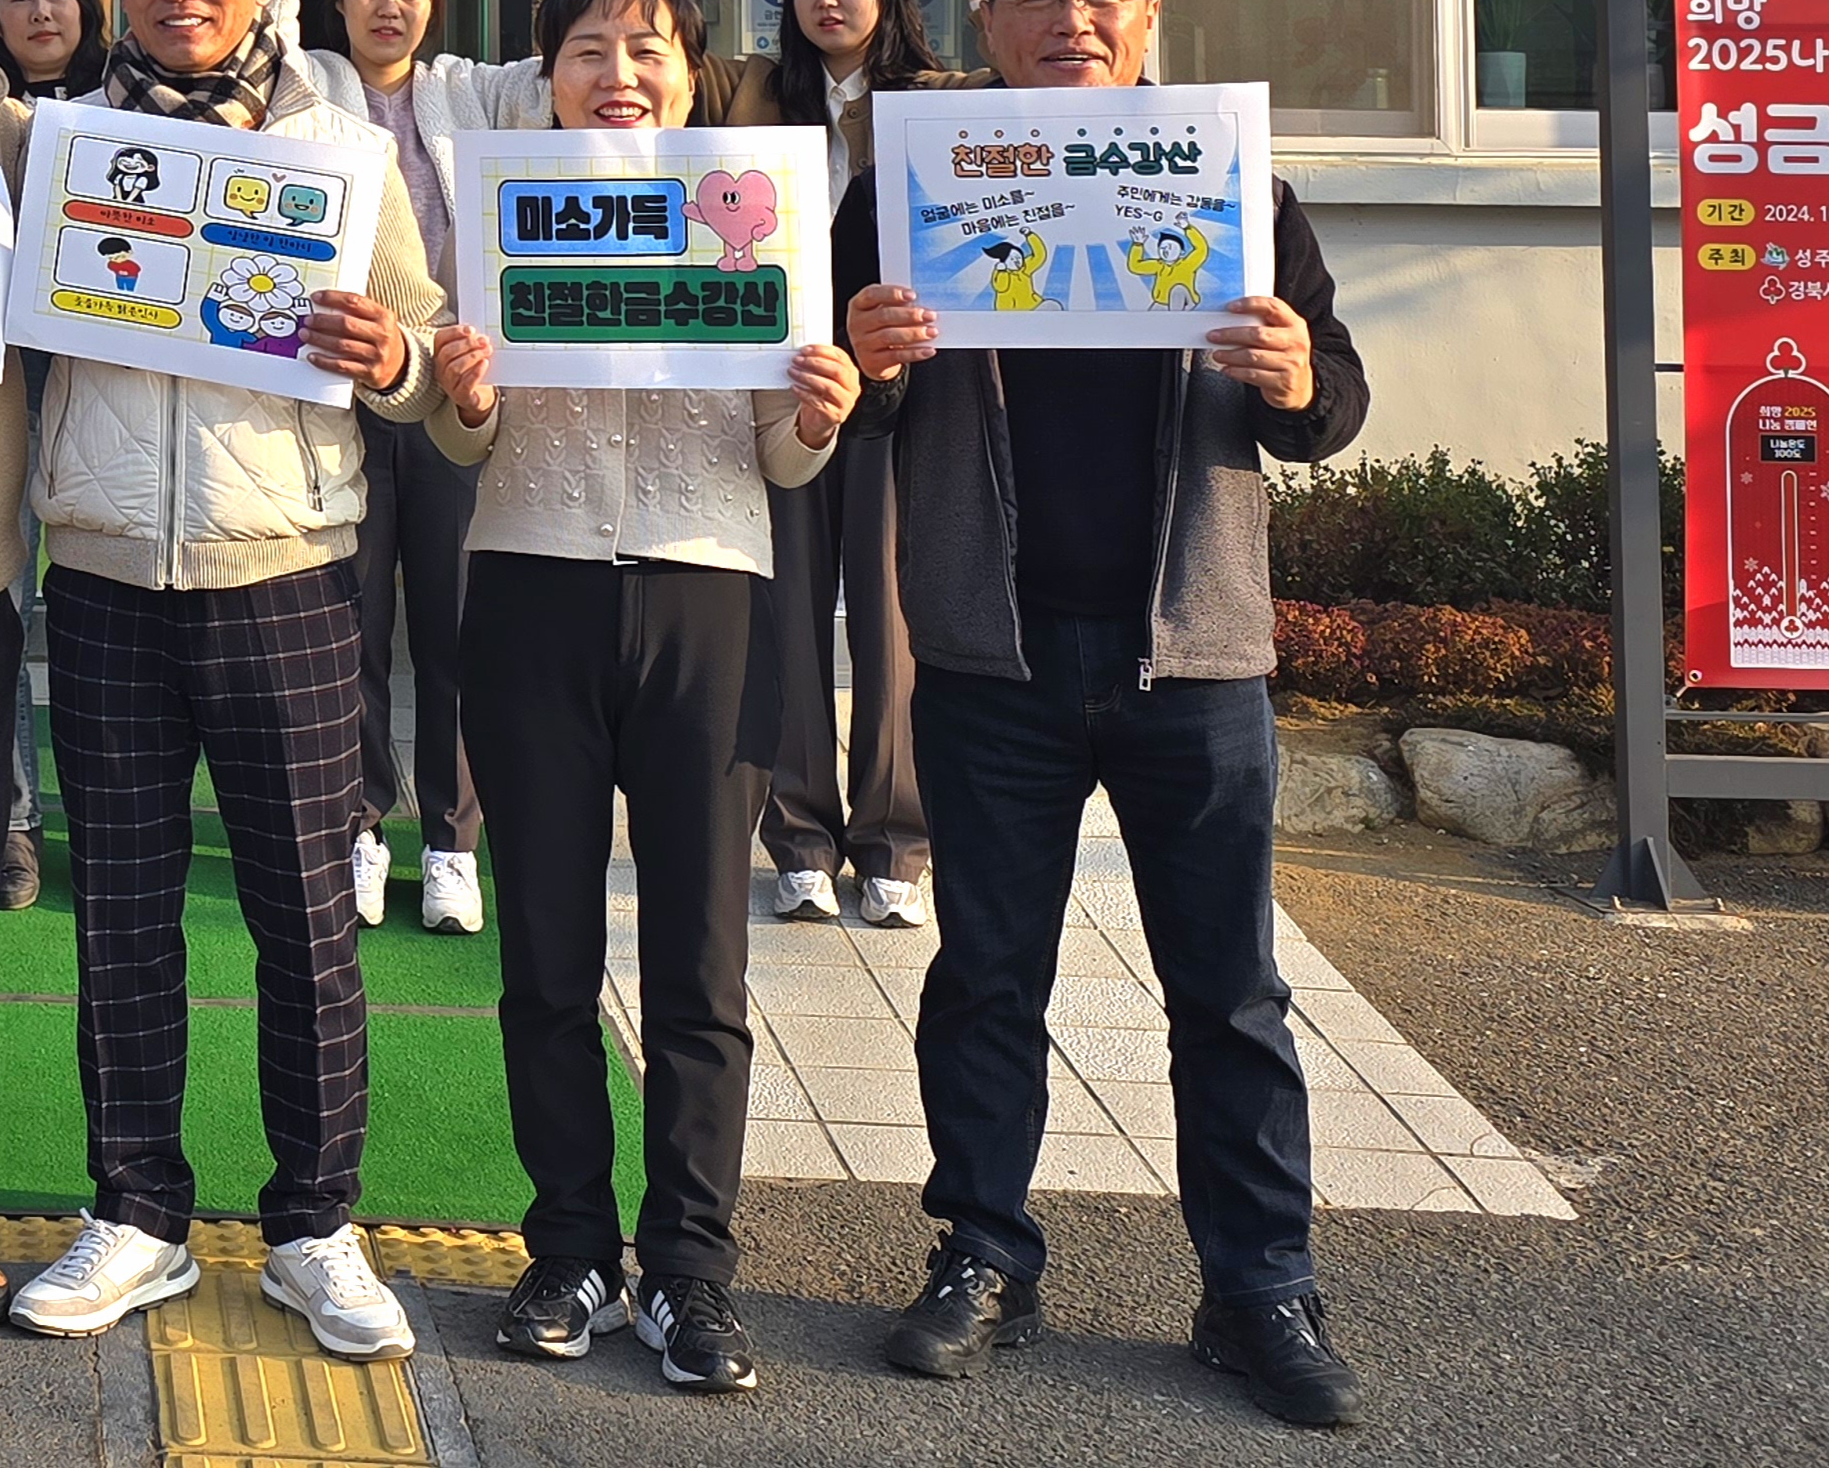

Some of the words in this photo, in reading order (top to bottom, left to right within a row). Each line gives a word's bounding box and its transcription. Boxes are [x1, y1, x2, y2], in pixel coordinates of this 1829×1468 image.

[1688, 102, 1829, 174] 성금
[951, 142, 1055, 178] 친절한
[1063, 141, 1203, 177] 금수강산
[1117, 184, 1183, 207] 주민에게는
[516, 194, 668, 242] 미소가득
[920, 202, 979, 223] 얼굴에는
[1707, 203, 1745, 221] 기간
[1764, 204, 1814, 222] 2024.
[960, 214, 1020, 237] 마음에는
[1708, 247, 1745, 267] 주최
[509, 280, 779, 327] 친절한금수강산
[1784, 406, 1816, 418] 2025
